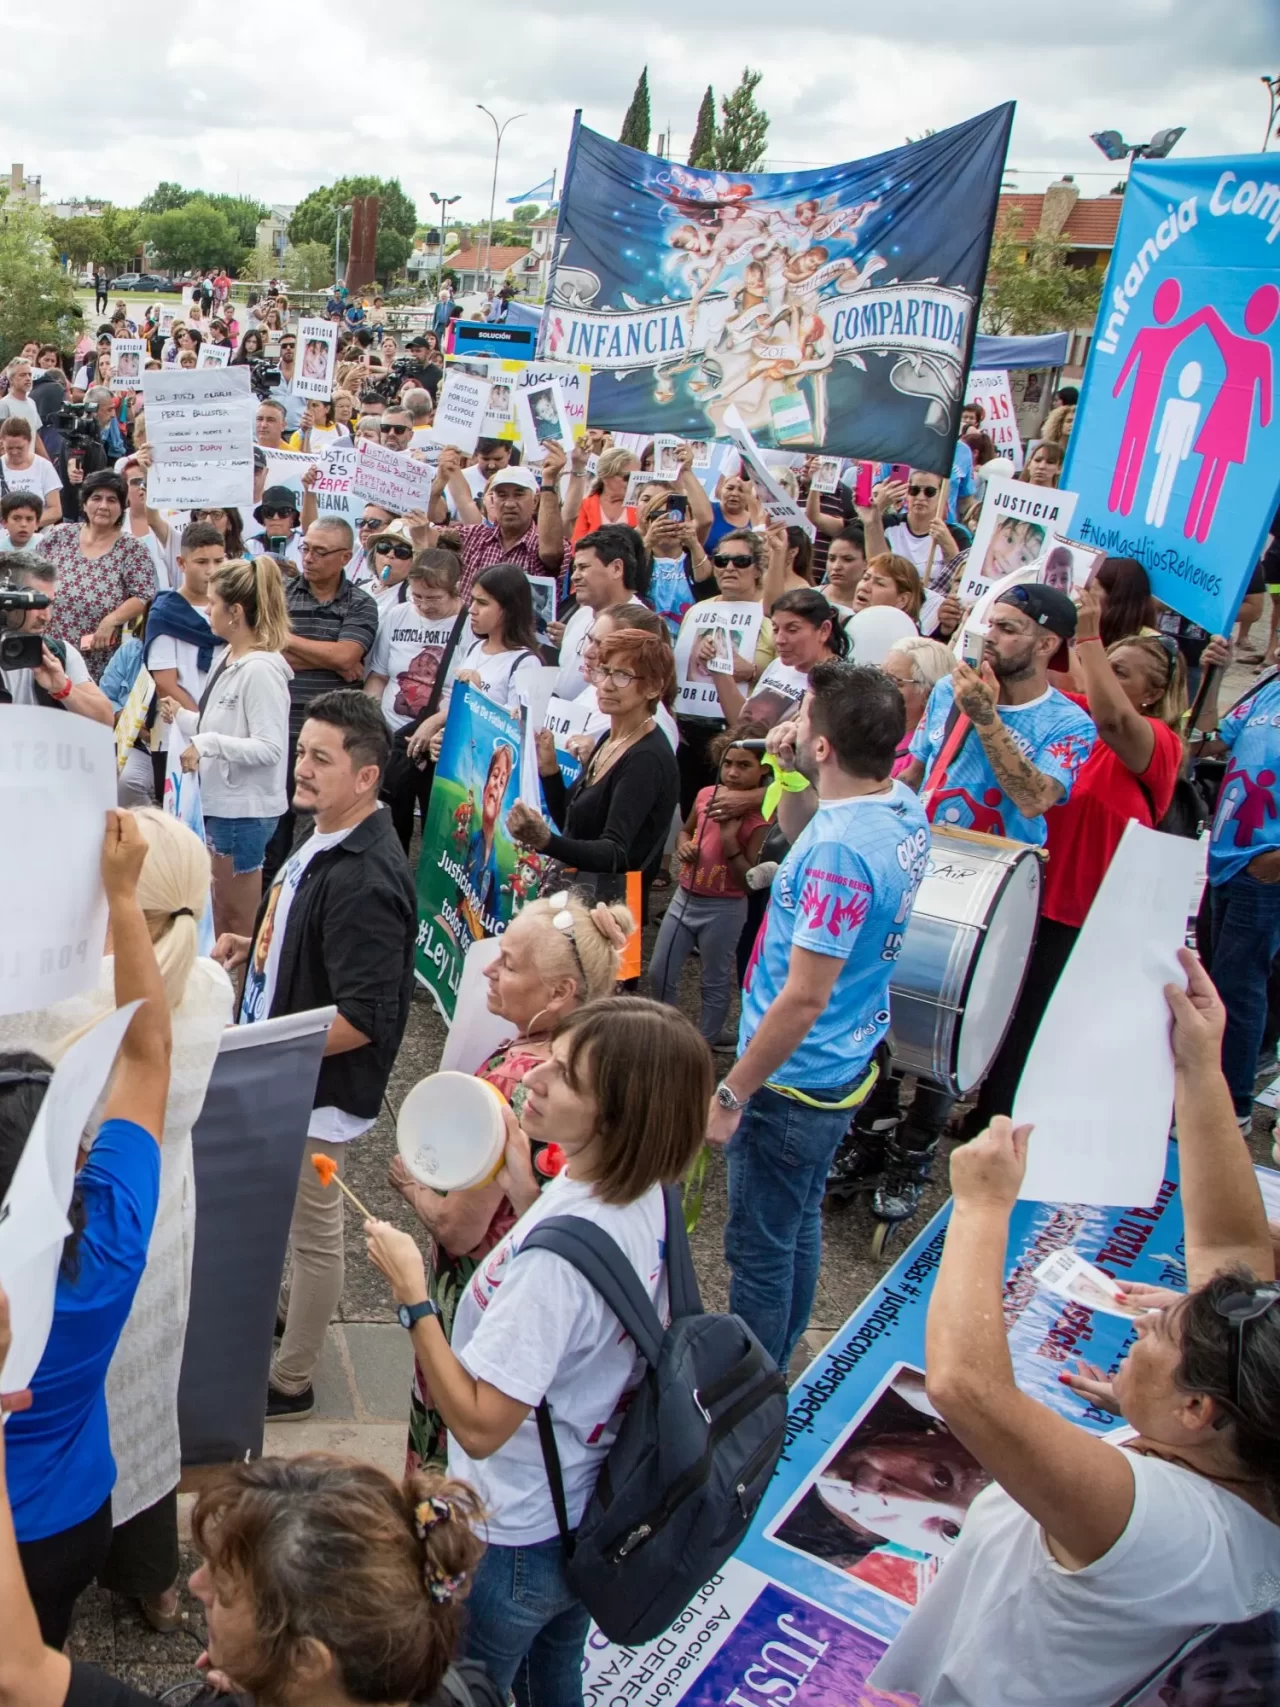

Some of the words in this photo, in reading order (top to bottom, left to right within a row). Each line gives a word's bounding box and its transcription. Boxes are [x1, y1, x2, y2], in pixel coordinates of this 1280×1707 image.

[1096, 196, 1198, 355] Infancia
[832, 299, 964, 348] COMPARTIDA
[302, 326, 333, 338] JUSTICIA
[478, 331, 511, 340] SOLUCIÓN
[567, 314, 685, 358] INFANCIA
[203, 348, 226, 357] JUSTICIA
[296, 380, 308, 390] POR
[310, 382, 328, 394] LUCIO
[453, 383, 479, 395] JUSTICIA
[447, 392, 461, 402] POR
[461, 395, 479, 407] LUCIO
[446, 404, 476, 418] CLAYPOLE
[443, 414, 473, 429] PRESENTE
[658, 438, 678, 446] JUSTIC
[329, 464, 348, 476] ES
[994, 492, 1060, 522] JUSTICIA
[1080, 517, 1223, 597] #NoMasHijosRehenes
[695, 612, 753, 627] JUSCIA
[392, 628, 422, 643] JUSTICIA
[423, 629, 440, 645] POR
[677, 687, 697, 700] POR
[437, 850, 471, 897] Justicia
[470, 890, 481, 915] por
[825, 872, 848, 886] HIJOS
[442, 898, 463, 939] todos
[461, 923, 470, 955] los
[415, 919, 449, 980] #Ley
[1095, 1218, 1155, 1269] TOTAL
[695, 1573, 725, 1606] por
[671, 1604, 703, 1635] los
